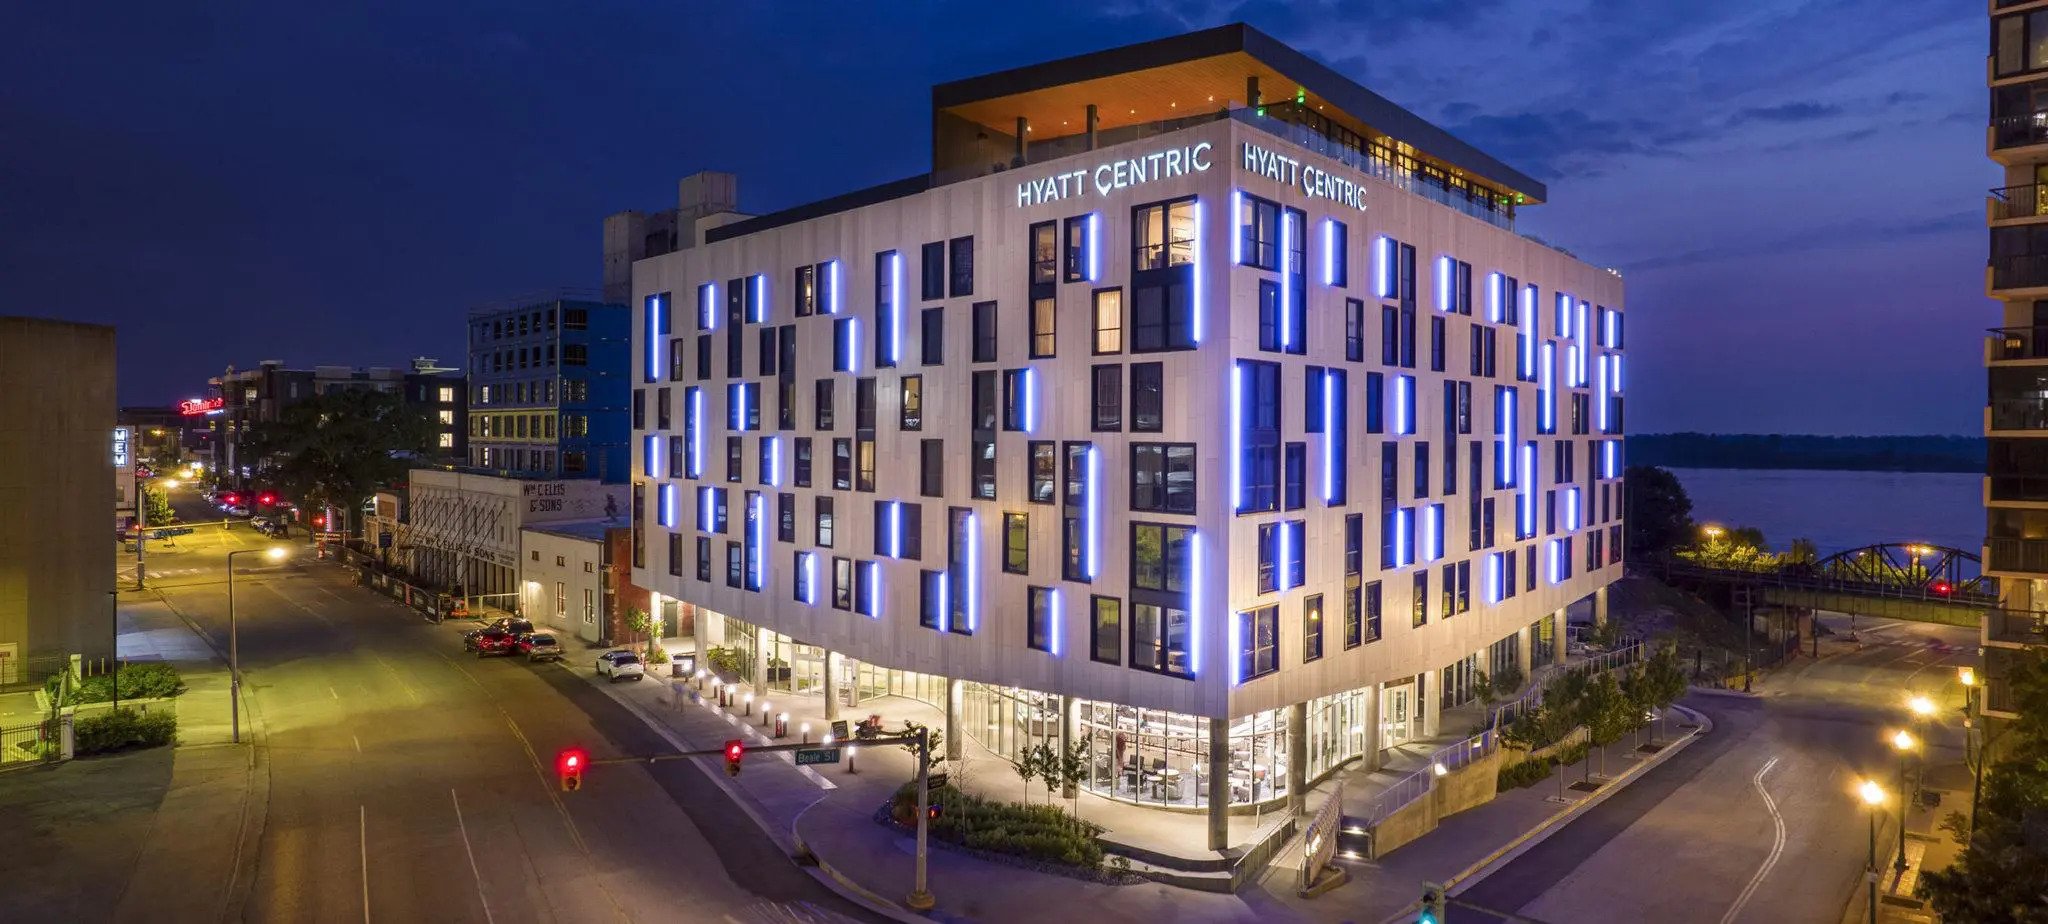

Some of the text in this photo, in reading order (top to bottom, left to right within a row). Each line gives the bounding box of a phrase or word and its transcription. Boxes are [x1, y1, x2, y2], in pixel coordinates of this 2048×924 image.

[1018, 142, 1212, 208] HYATT CENTRIC
[1244, 142, 1368, 212] HYATT CENTRIC
[545, 483, 566, 496] ELLIS
[539, 499, 562, 512] SONS
[474, 547, 496, 561] SONS
